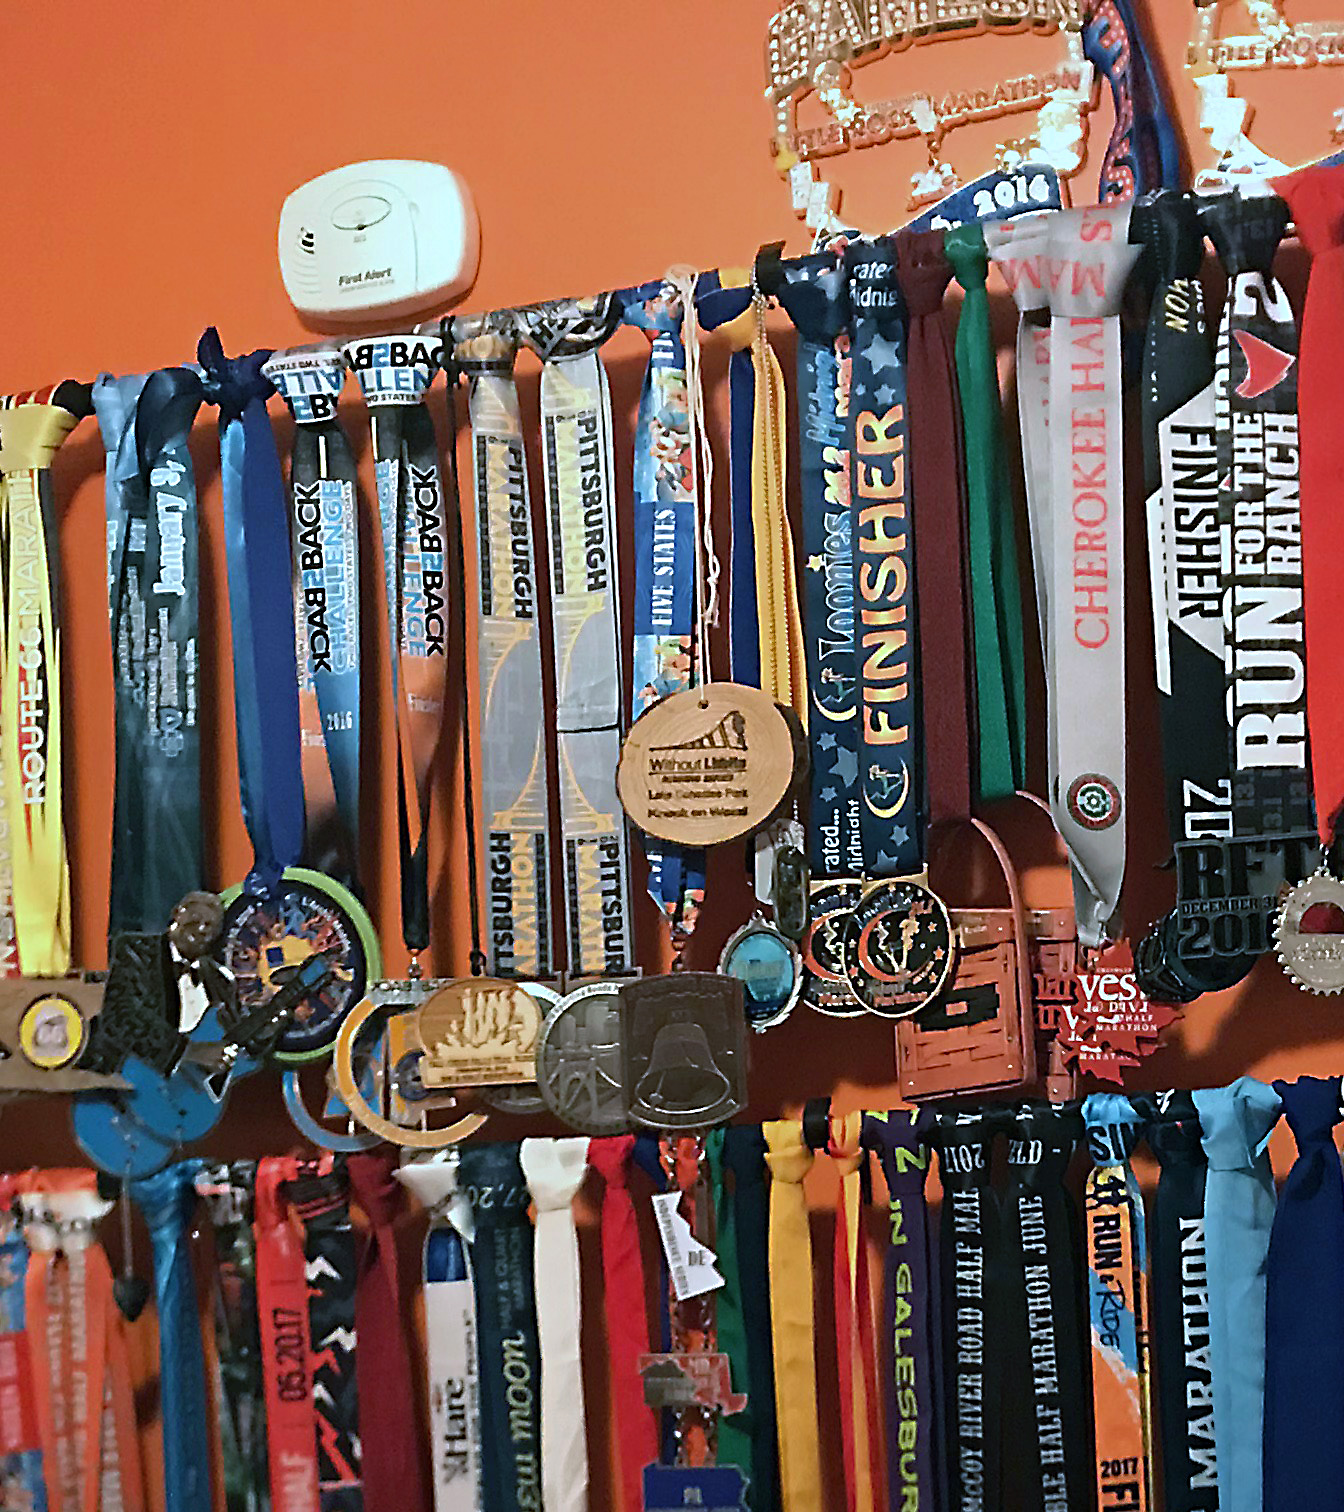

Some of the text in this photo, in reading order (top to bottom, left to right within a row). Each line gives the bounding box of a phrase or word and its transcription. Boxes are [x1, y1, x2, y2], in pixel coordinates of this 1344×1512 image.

[973, 174, 1051, 216] 2016
[153, 491, 187, 595] January
[489, 446, 515, 617] MARATHON
[507, 446, 534, 619] PITTSBURGH
[556, 420, 584, 594] MARATHON
[578, 413, 607, 593] PITTSBURGH
[1073, 408, 1109, 648] CHEROKEE
[1170, 424, 1223, 620] FINISHER
[1233, 412, 1266, 575] FOR THE
[1265, 413, 1299, 575] RANCH
[652, 509, 676, 625] FIVE STATES
[855, 404, 908, 745] FINISHER
[19, 626, 45, 805] ROUTE 66
[1235, 583, 1306, 769] RUN
[490, 832, 514, 976] TTSBURGH
[511, 833, 536, 975] ARATHON
[578, 844, 606, 971] MARATH
[598, 841, 623, 972] PITTSBUR
[1181, 914, 1278, 960] 201
[1182, 898, 1257, 915] DECEMBER
[955, 1240, 982, 1299] HALF
[1018, 1195, 1047, 1256] JUNE
[1093, 1213, 1122, 1270] RUN
[956, 1307, 983, 1365] ROAD
[1025, 1264, 1059, 1395] MARATHON
[1178, 1216, 1220, 1500] MARATHON
[958, 1372, 983, 1440] RIVER
[1036, 1402, 1065, 1465] HALF
[1101, 1458, 1138, 1477] 2017
